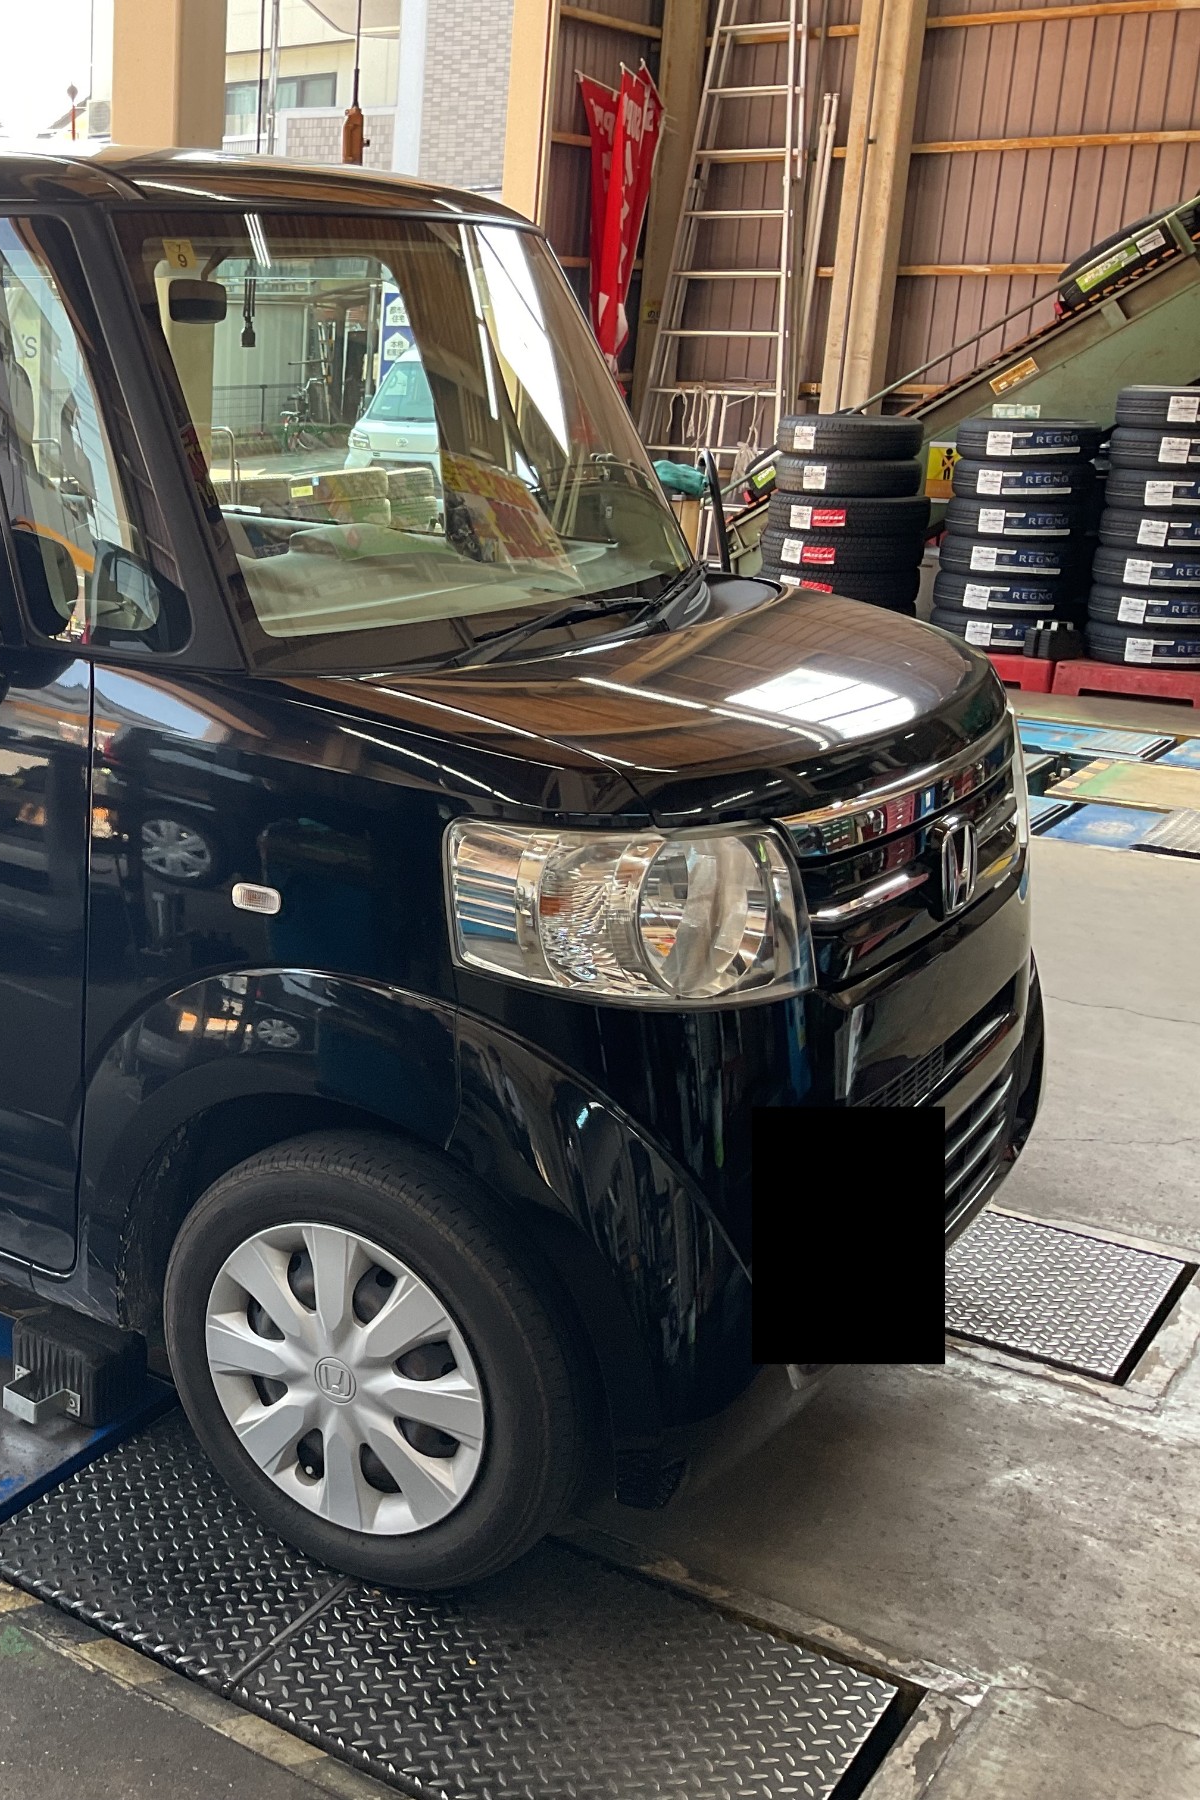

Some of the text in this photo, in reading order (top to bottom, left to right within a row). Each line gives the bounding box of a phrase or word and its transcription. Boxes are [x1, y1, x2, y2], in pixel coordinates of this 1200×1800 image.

[177, 253, 188, 268] 9
[1035, 434, 1079, 445] REGNO
[1024, 475, 1070, 485] REGNO
[1028, 516, 1069, 526] REGNO
[1018, 553, 1060, 564] REGNO
[1012, 590, 1054, 600] REGNO
